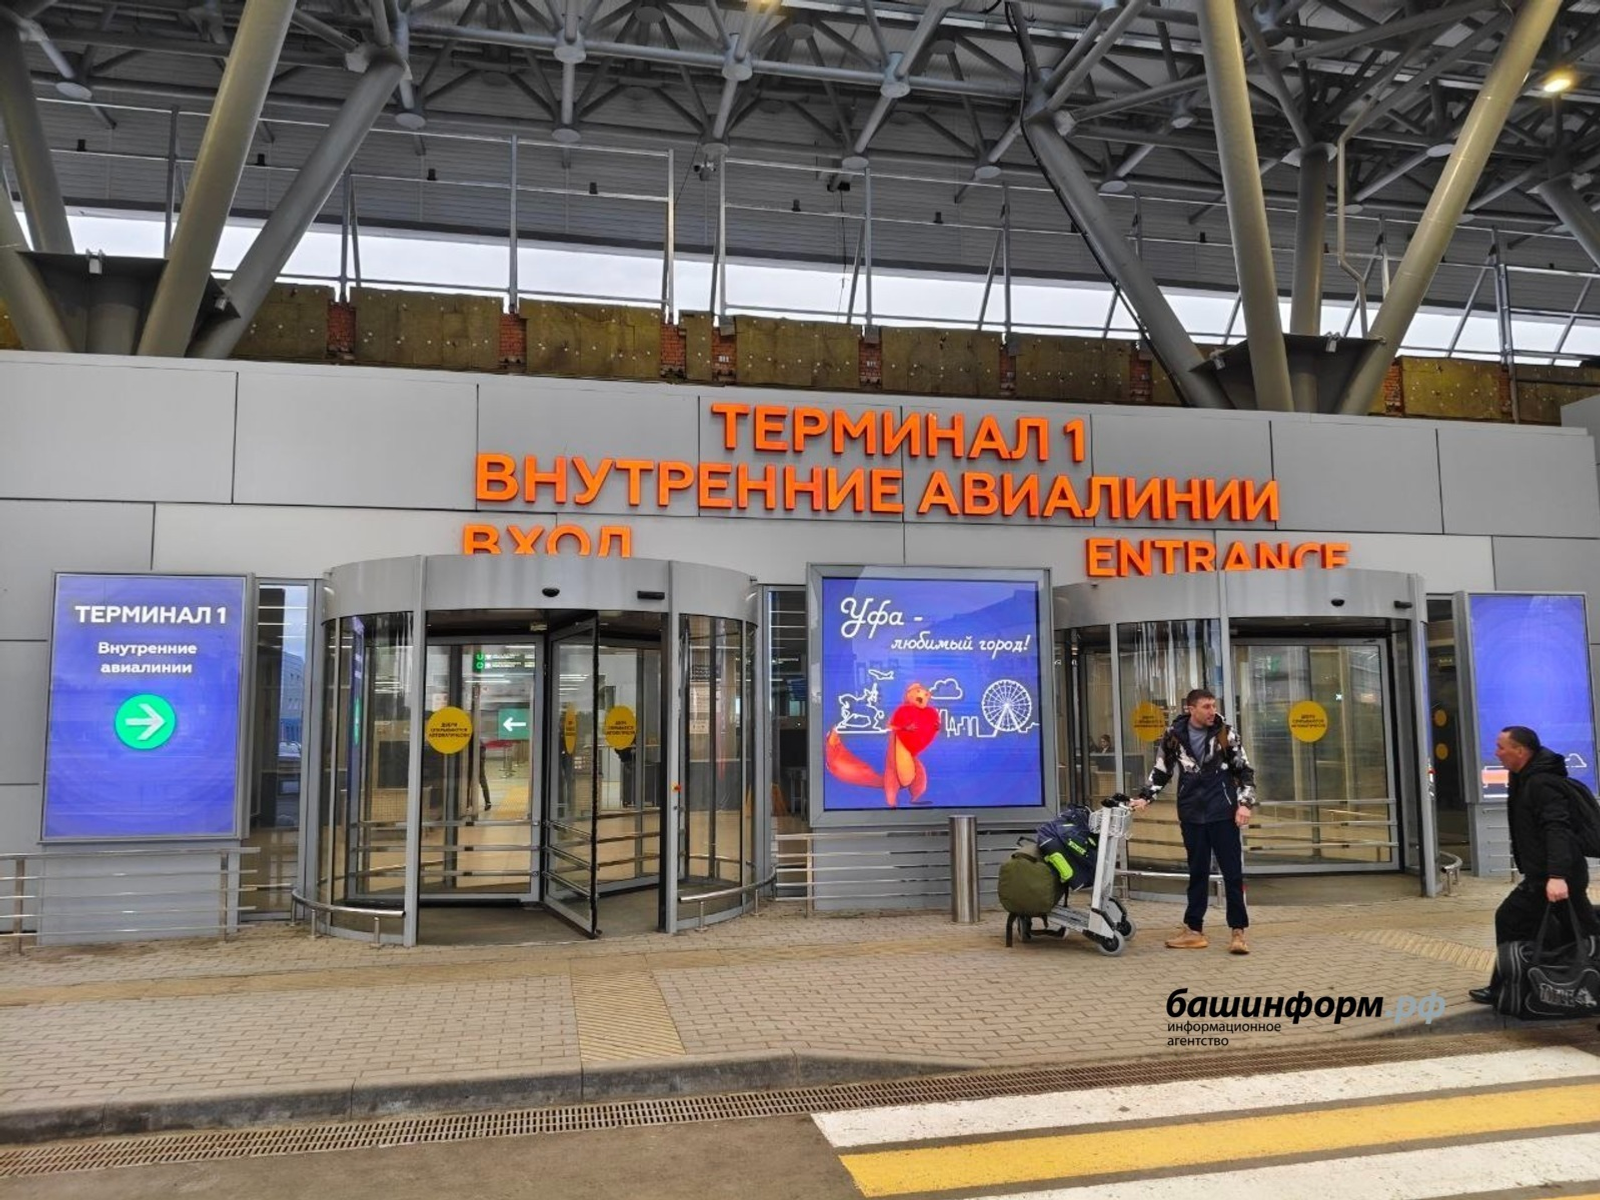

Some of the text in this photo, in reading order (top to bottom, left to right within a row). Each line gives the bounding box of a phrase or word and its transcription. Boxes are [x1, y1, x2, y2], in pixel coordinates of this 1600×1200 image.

[711, 402, 1085, 462] ТЕРМИНАЛ 1
[475, 452, 1280, 521] ВНУТРЕННИЕ АВИАЛИНИИ
[1086, 537, 1349, 577] ENTRANCE
[74, 605, 227, 624] ТЕРМИНАЛ 1
[840, 597, 905, 639] Уфа
[98, 641, 198, 657] Внутренние
[890, 630, 1032, 660] любимый город!
[100, 663, 193, 674] авиалинии
